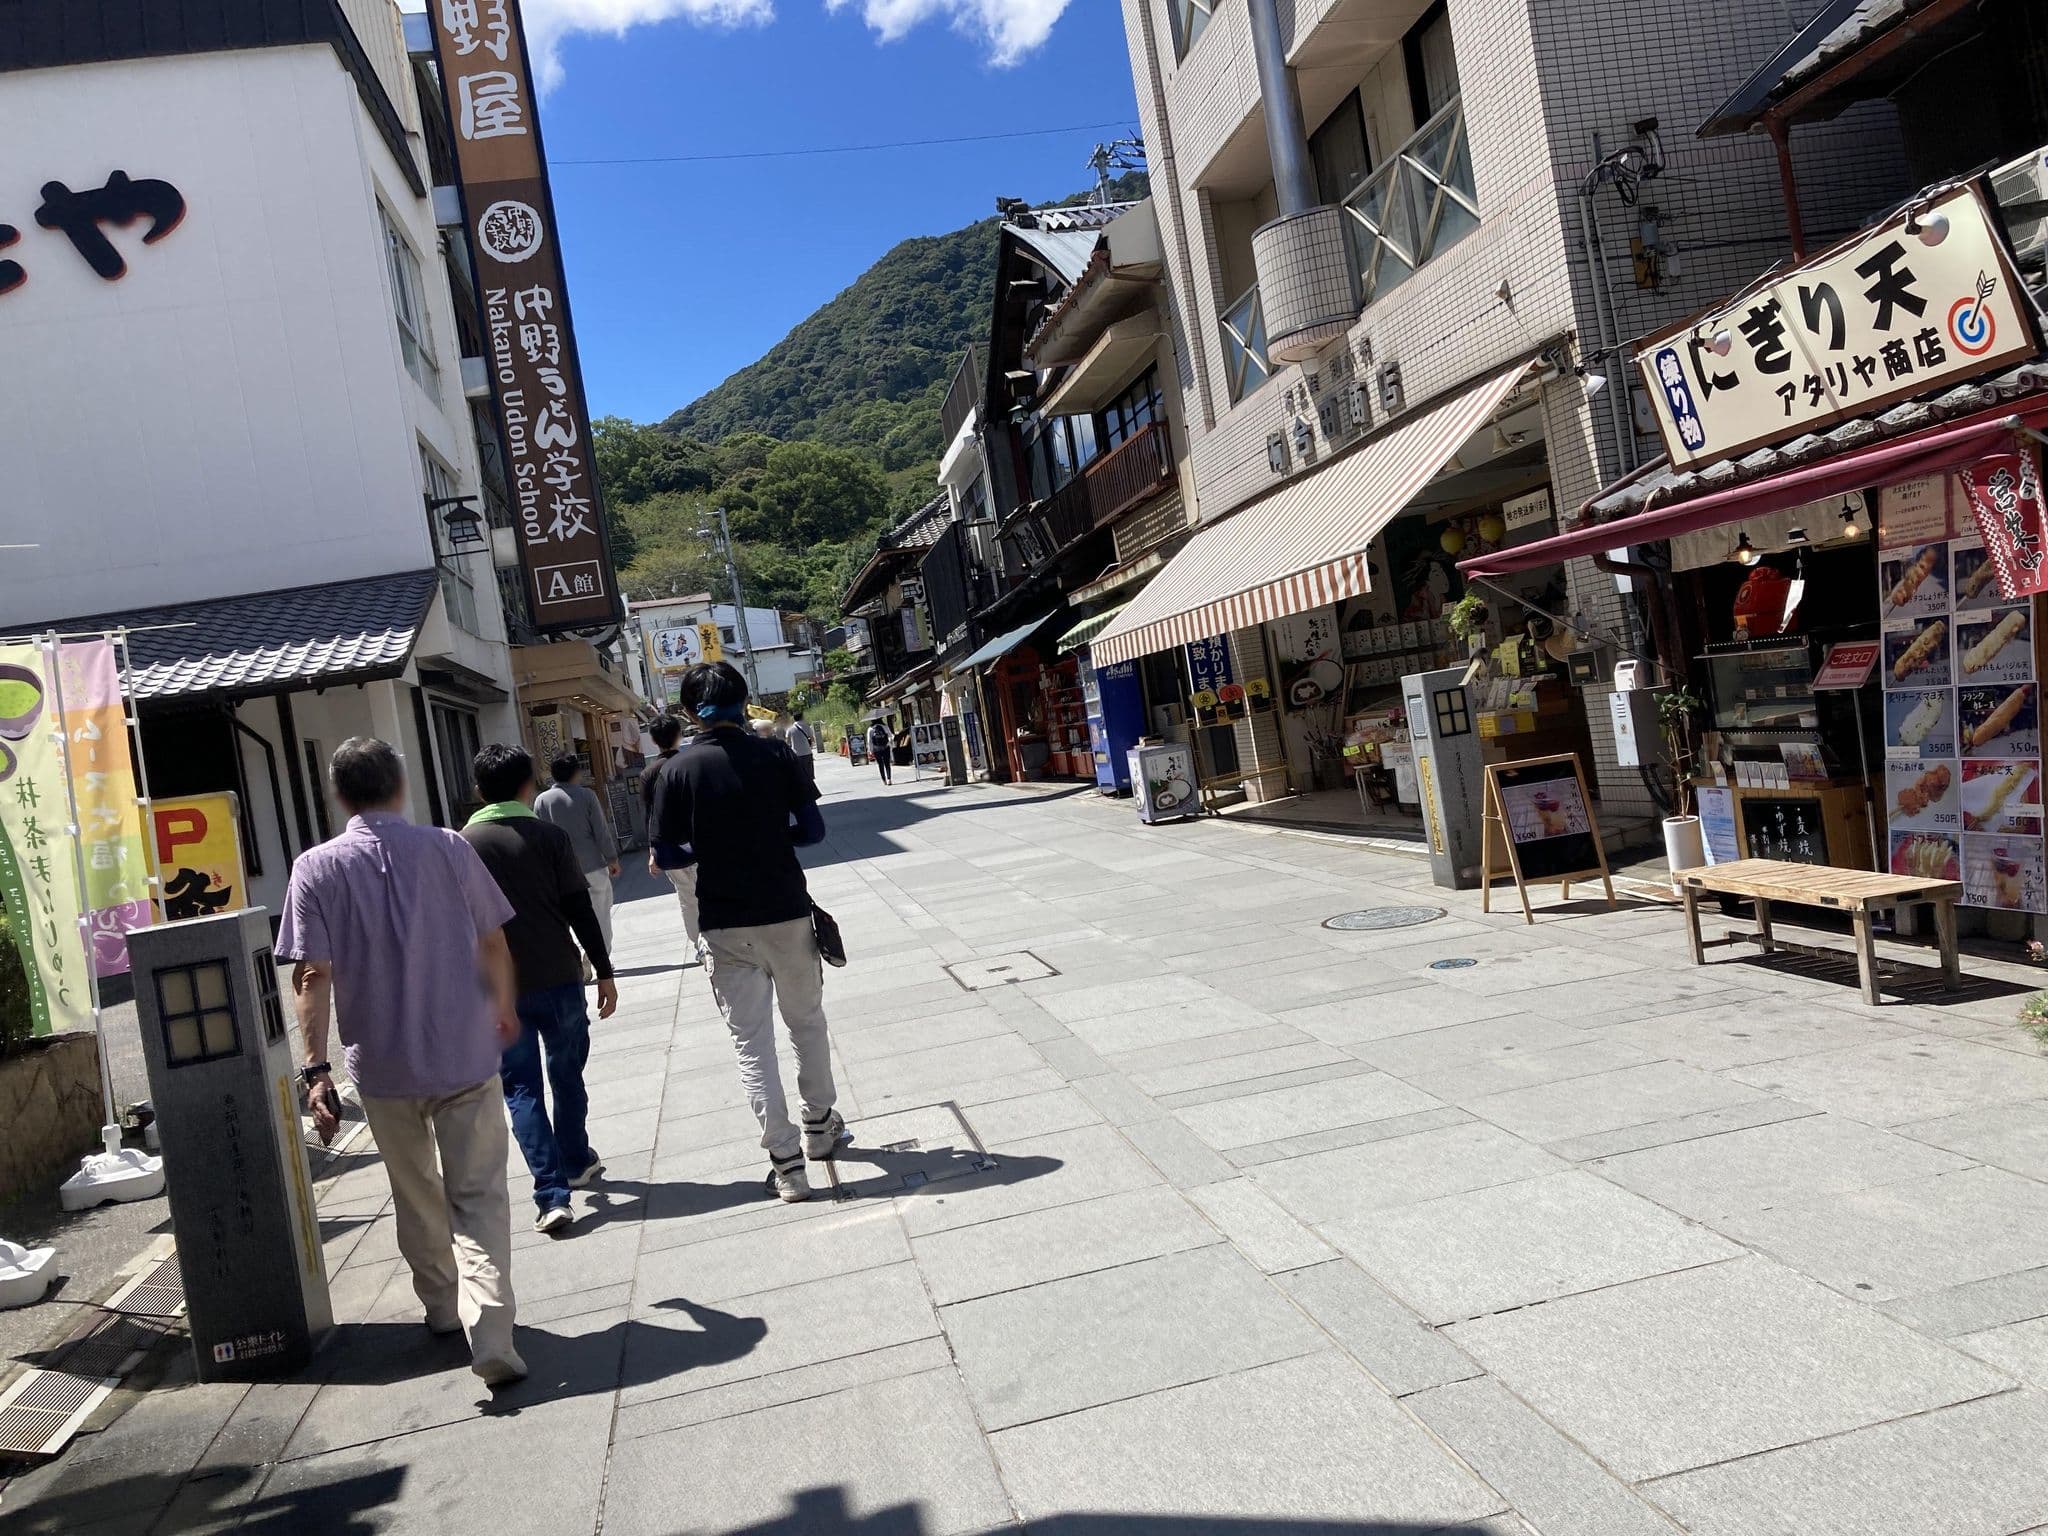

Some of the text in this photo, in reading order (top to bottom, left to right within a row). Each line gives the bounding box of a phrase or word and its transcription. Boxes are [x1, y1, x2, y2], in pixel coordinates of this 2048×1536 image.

[0, 170, 187, 295] や
[1688, 240, 1928, 402] にぎり天
[1776, 327, 1947, 416] アタリヤ商店
[485, 287, 549, 546] Nakano Udon School
[514, 284, 597, 541] 中野うどん学校
[1988, 468, 2045, 585] 営業中
[548, 571, 594, 598] A館
[1927, 602, 1946, 611] 350円
[1928, 742, 1953, 753] 350円
[2010, 742, 2039, 754] 350円
[154, 808, 208, 864] P
[1935, 814, 1957, 824] 350円
